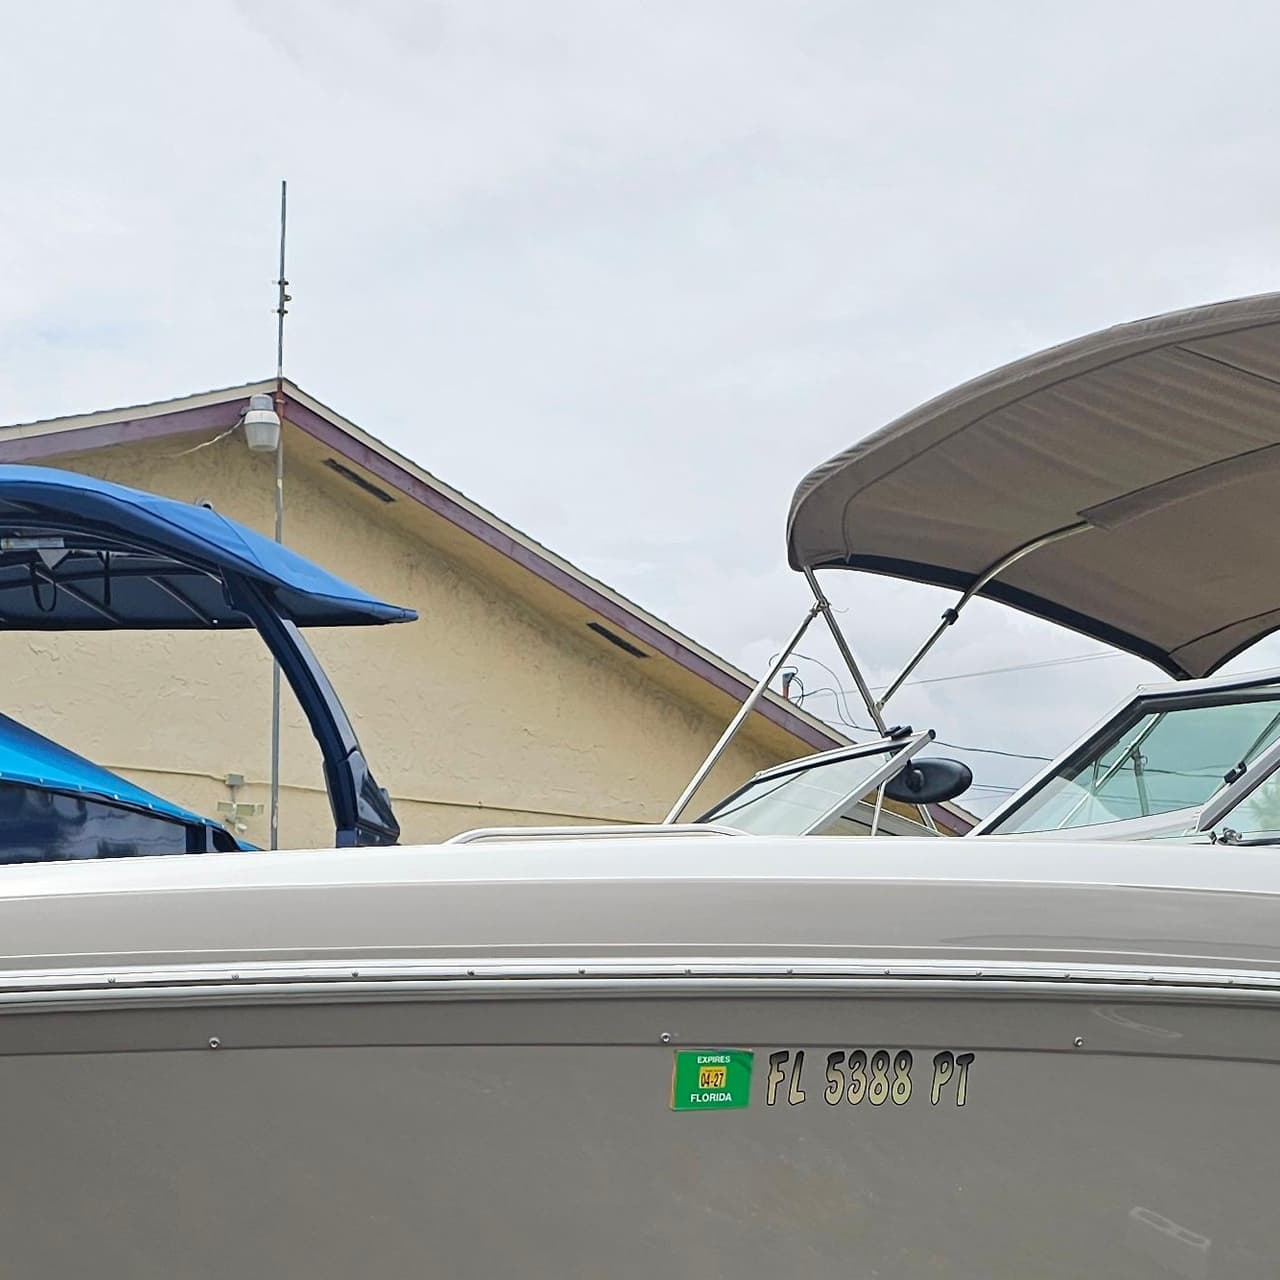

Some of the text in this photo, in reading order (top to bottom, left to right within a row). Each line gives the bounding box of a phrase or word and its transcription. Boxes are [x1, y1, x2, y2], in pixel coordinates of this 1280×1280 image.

[700, 1072, 724, 1087] 04-27
[767, 1050, 975, 1107] FL 5388 PT
[690, 1093, 732, 1102] FLORIDA
